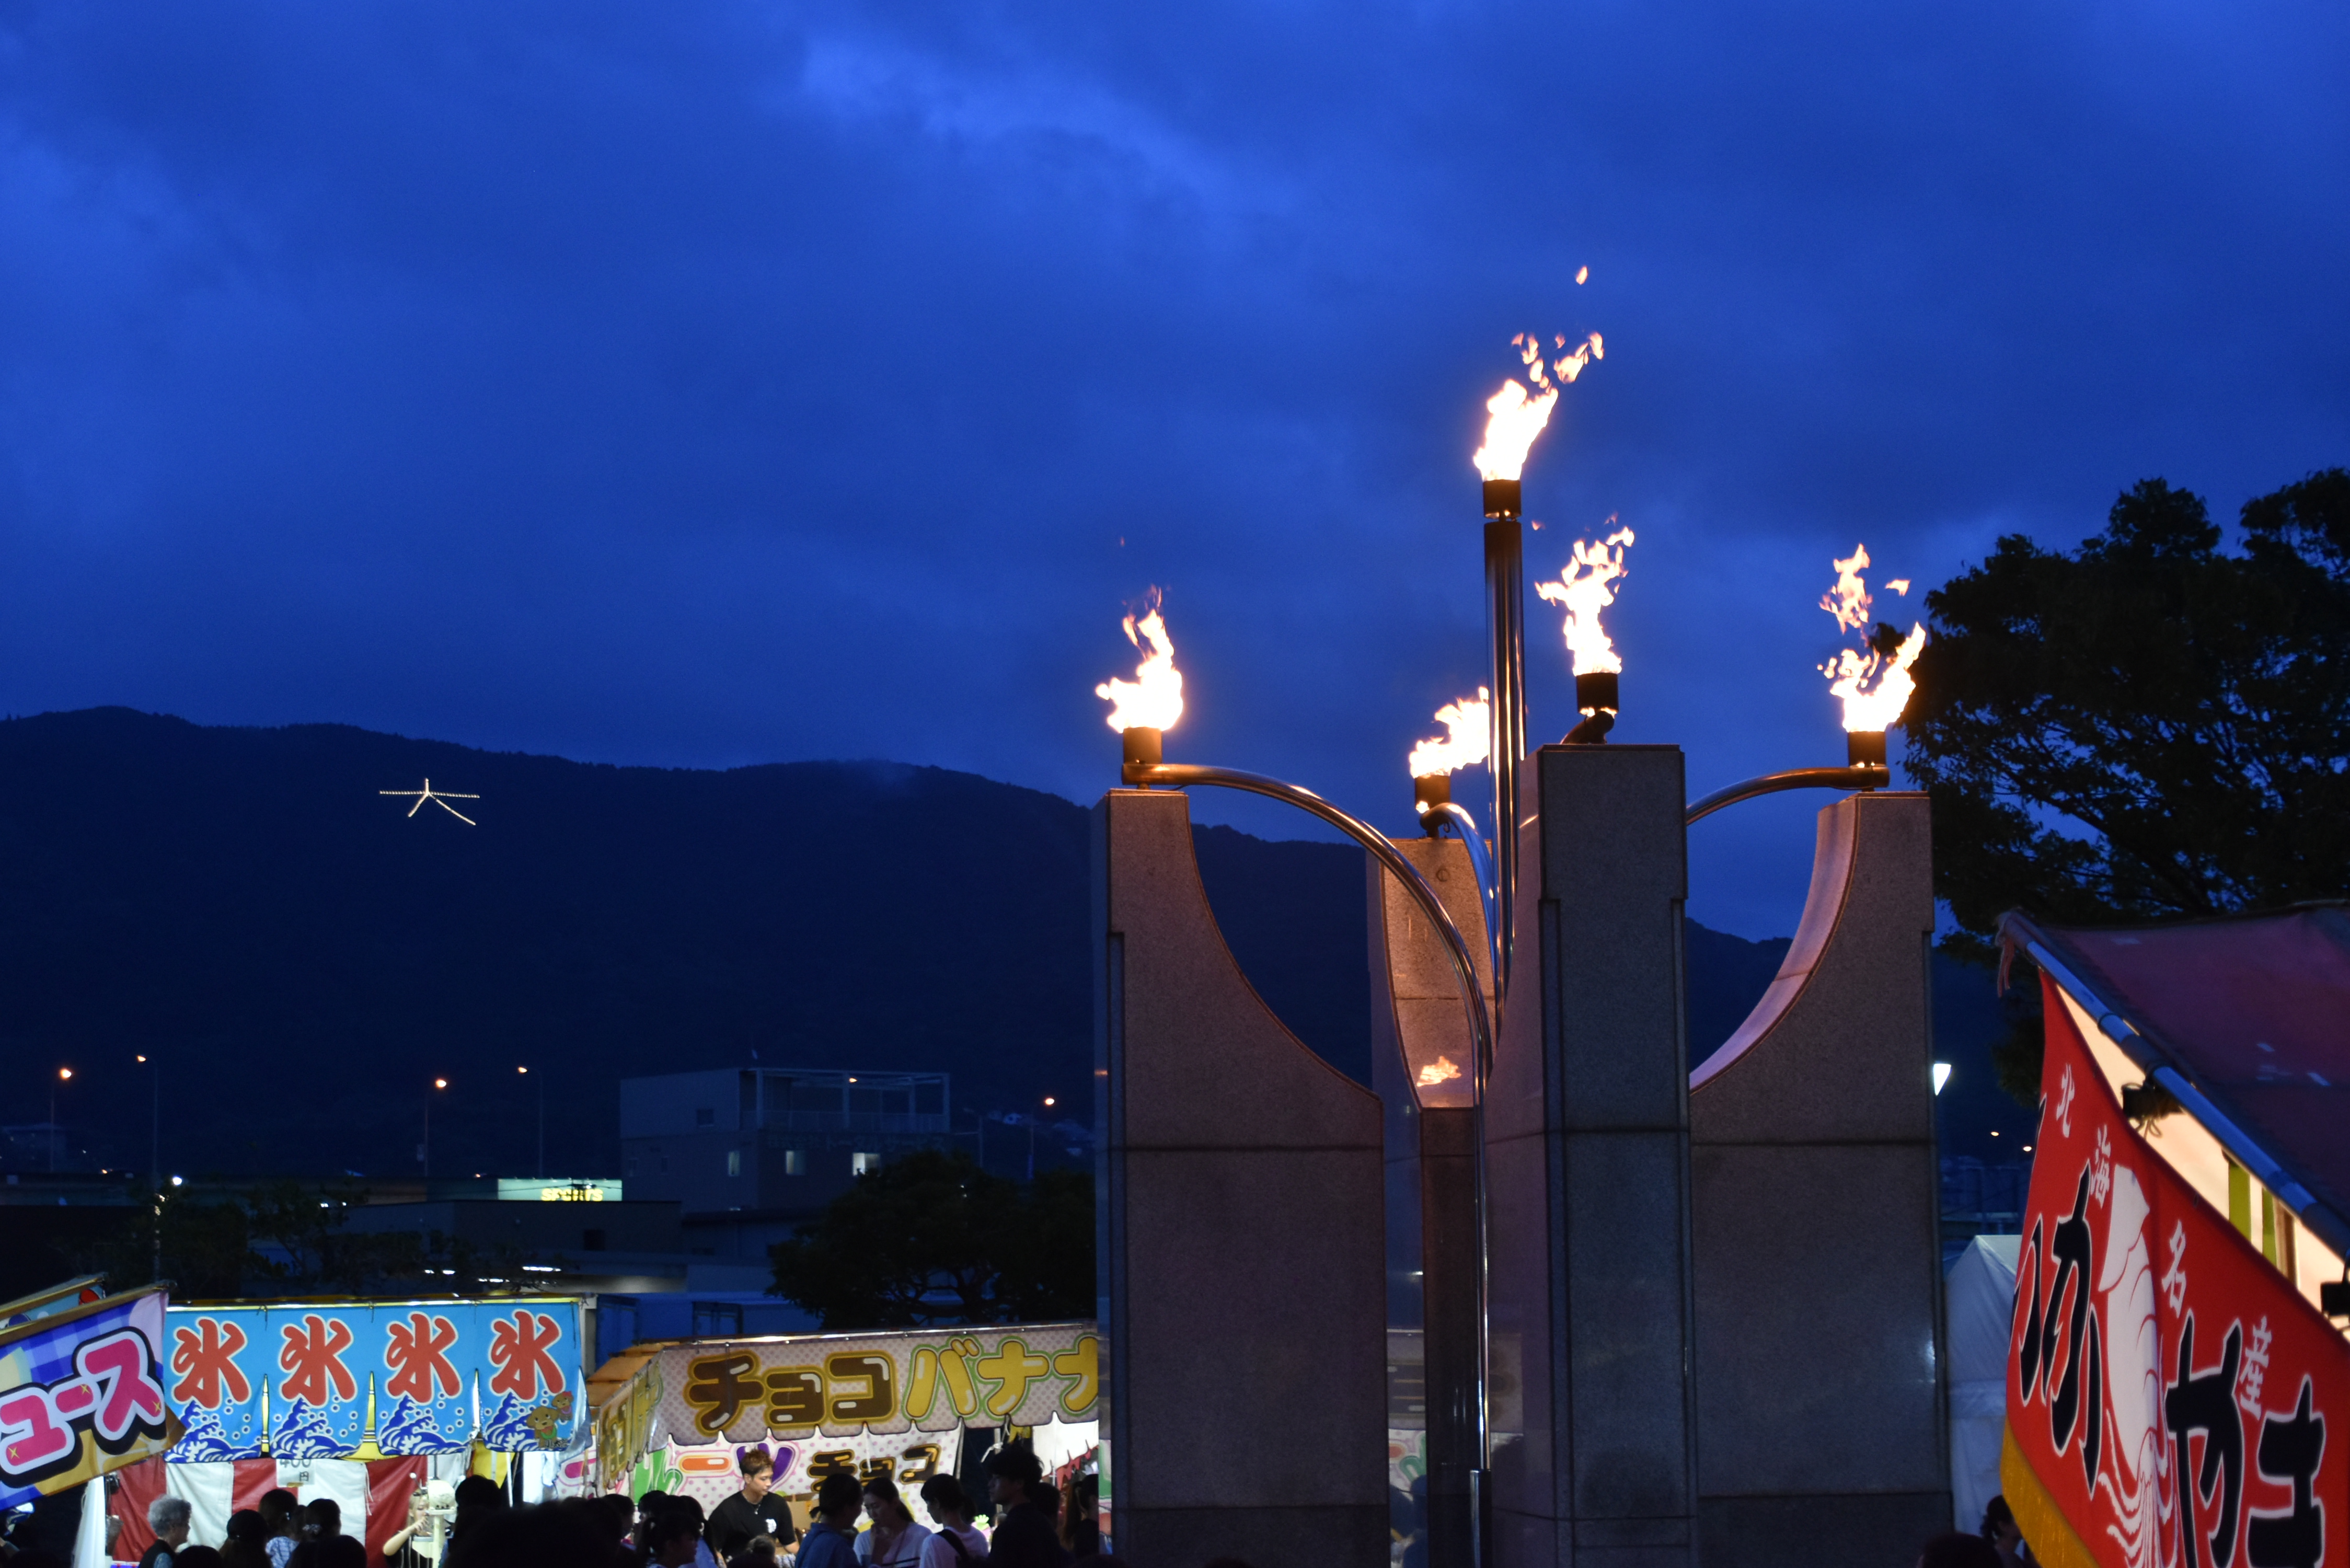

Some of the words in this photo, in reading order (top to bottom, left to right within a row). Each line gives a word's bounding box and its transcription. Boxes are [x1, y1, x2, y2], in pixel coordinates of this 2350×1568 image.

[172, 1317, 251, 1409] 氷
[280, 1314, 357, 1407] 氷
[384, 1311, 462, 1405] 氷
[489, 1309, 566, 1402] 氷
